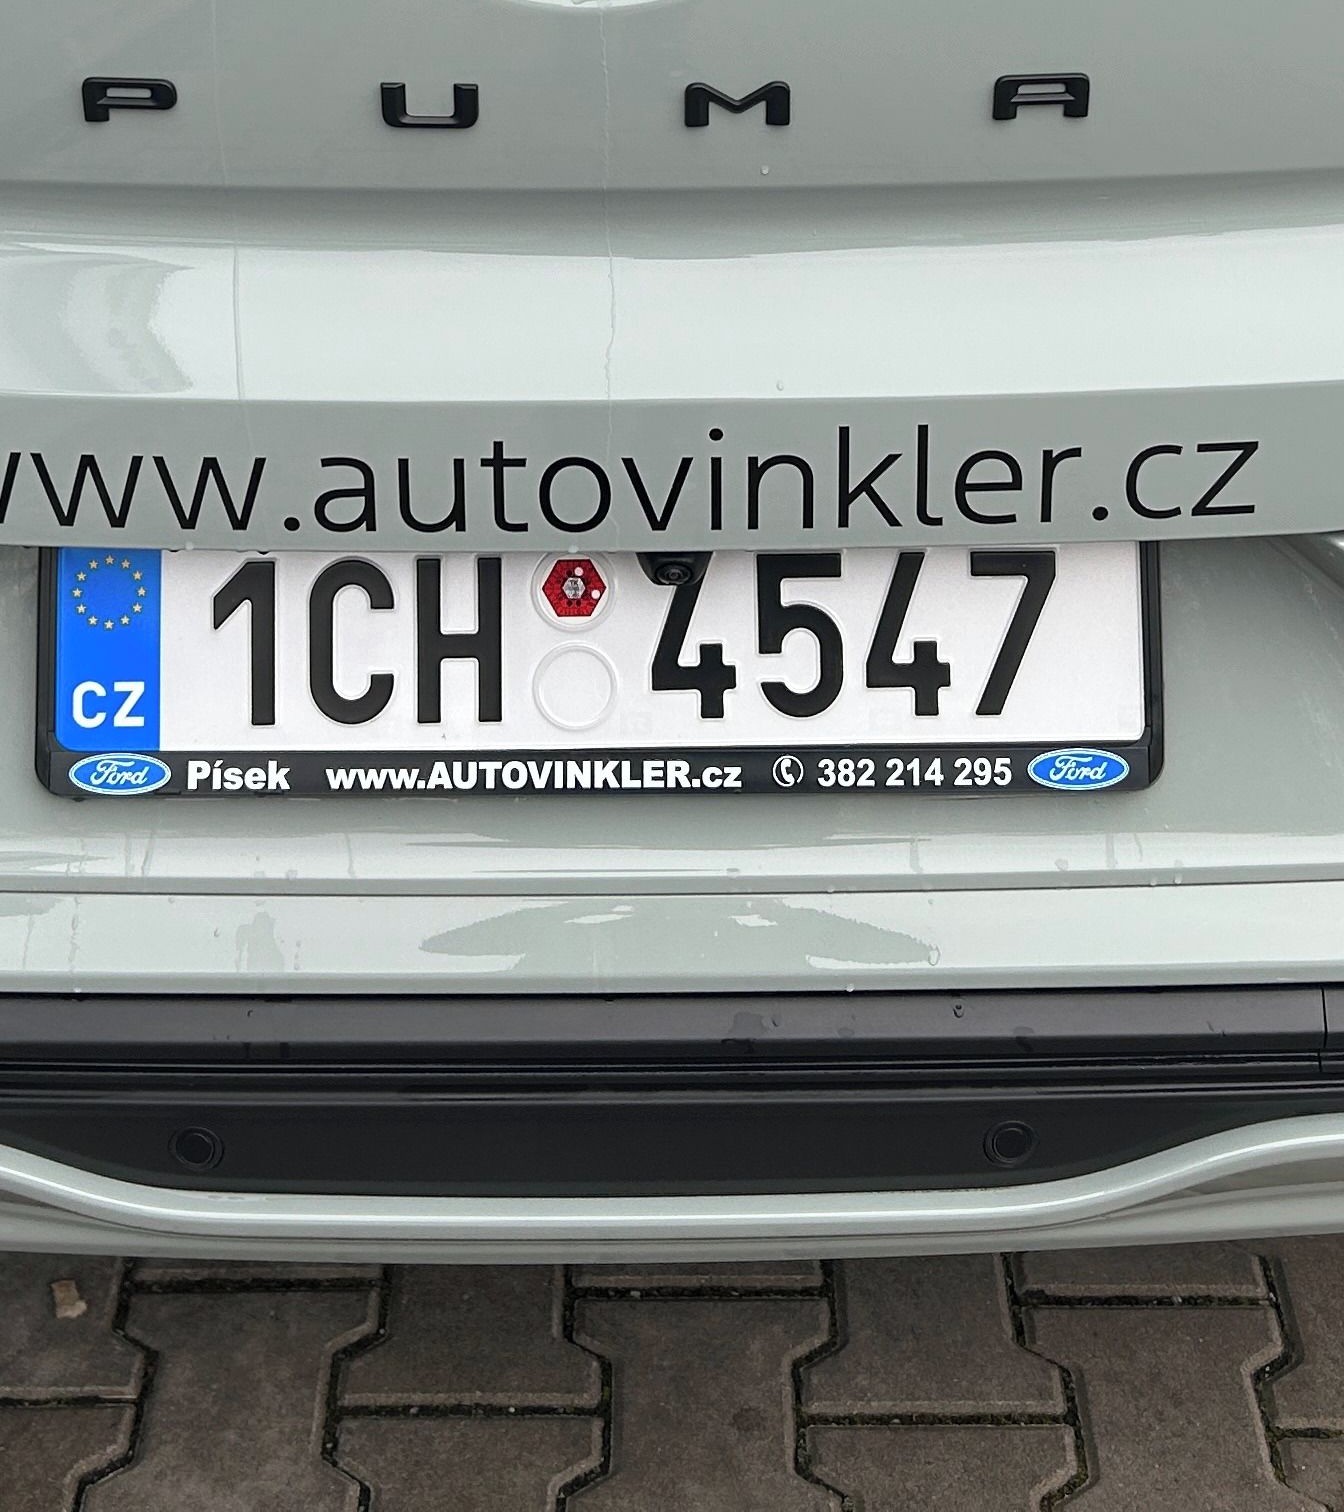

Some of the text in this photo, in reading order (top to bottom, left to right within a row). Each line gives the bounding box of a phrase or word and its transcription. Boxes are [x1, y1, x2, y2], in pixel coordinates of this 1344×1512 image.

[82, 71, 1090, 130] PUMA
[212, 552, 1056, 726] 1CH 4547
[72, 680, 145, 728] CZ
[89, 755, 1106, 790] Ford Písek www.AUTOVINKLER.cz 382 214 295 Ford
